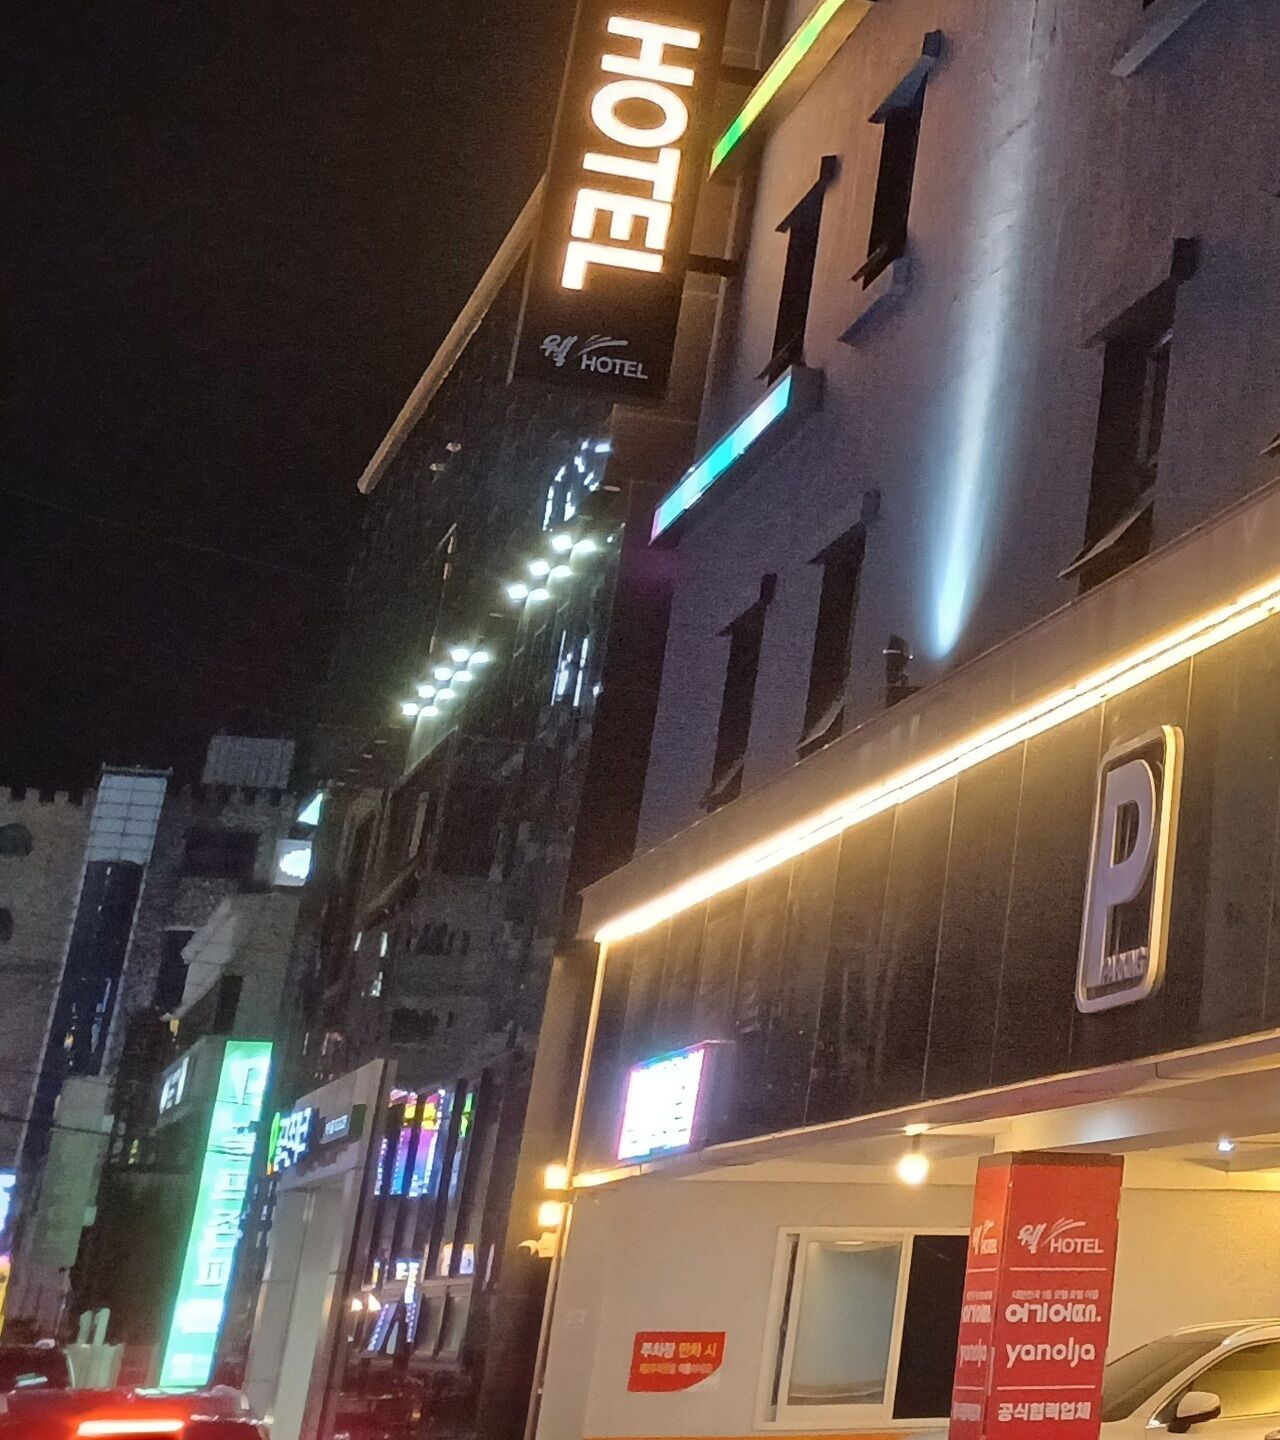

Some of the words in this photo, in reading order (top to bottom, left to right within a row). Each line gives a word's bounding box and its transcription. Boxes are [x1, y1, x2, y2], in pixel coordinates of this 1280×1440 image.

[561, 16, 701, 291] HOTEL
[580, 353, 648, 379] HOTEL
[1050, 1237, 1103, 1254] HOTEL
[1006, 1336, 1095, 1368] yanolja
